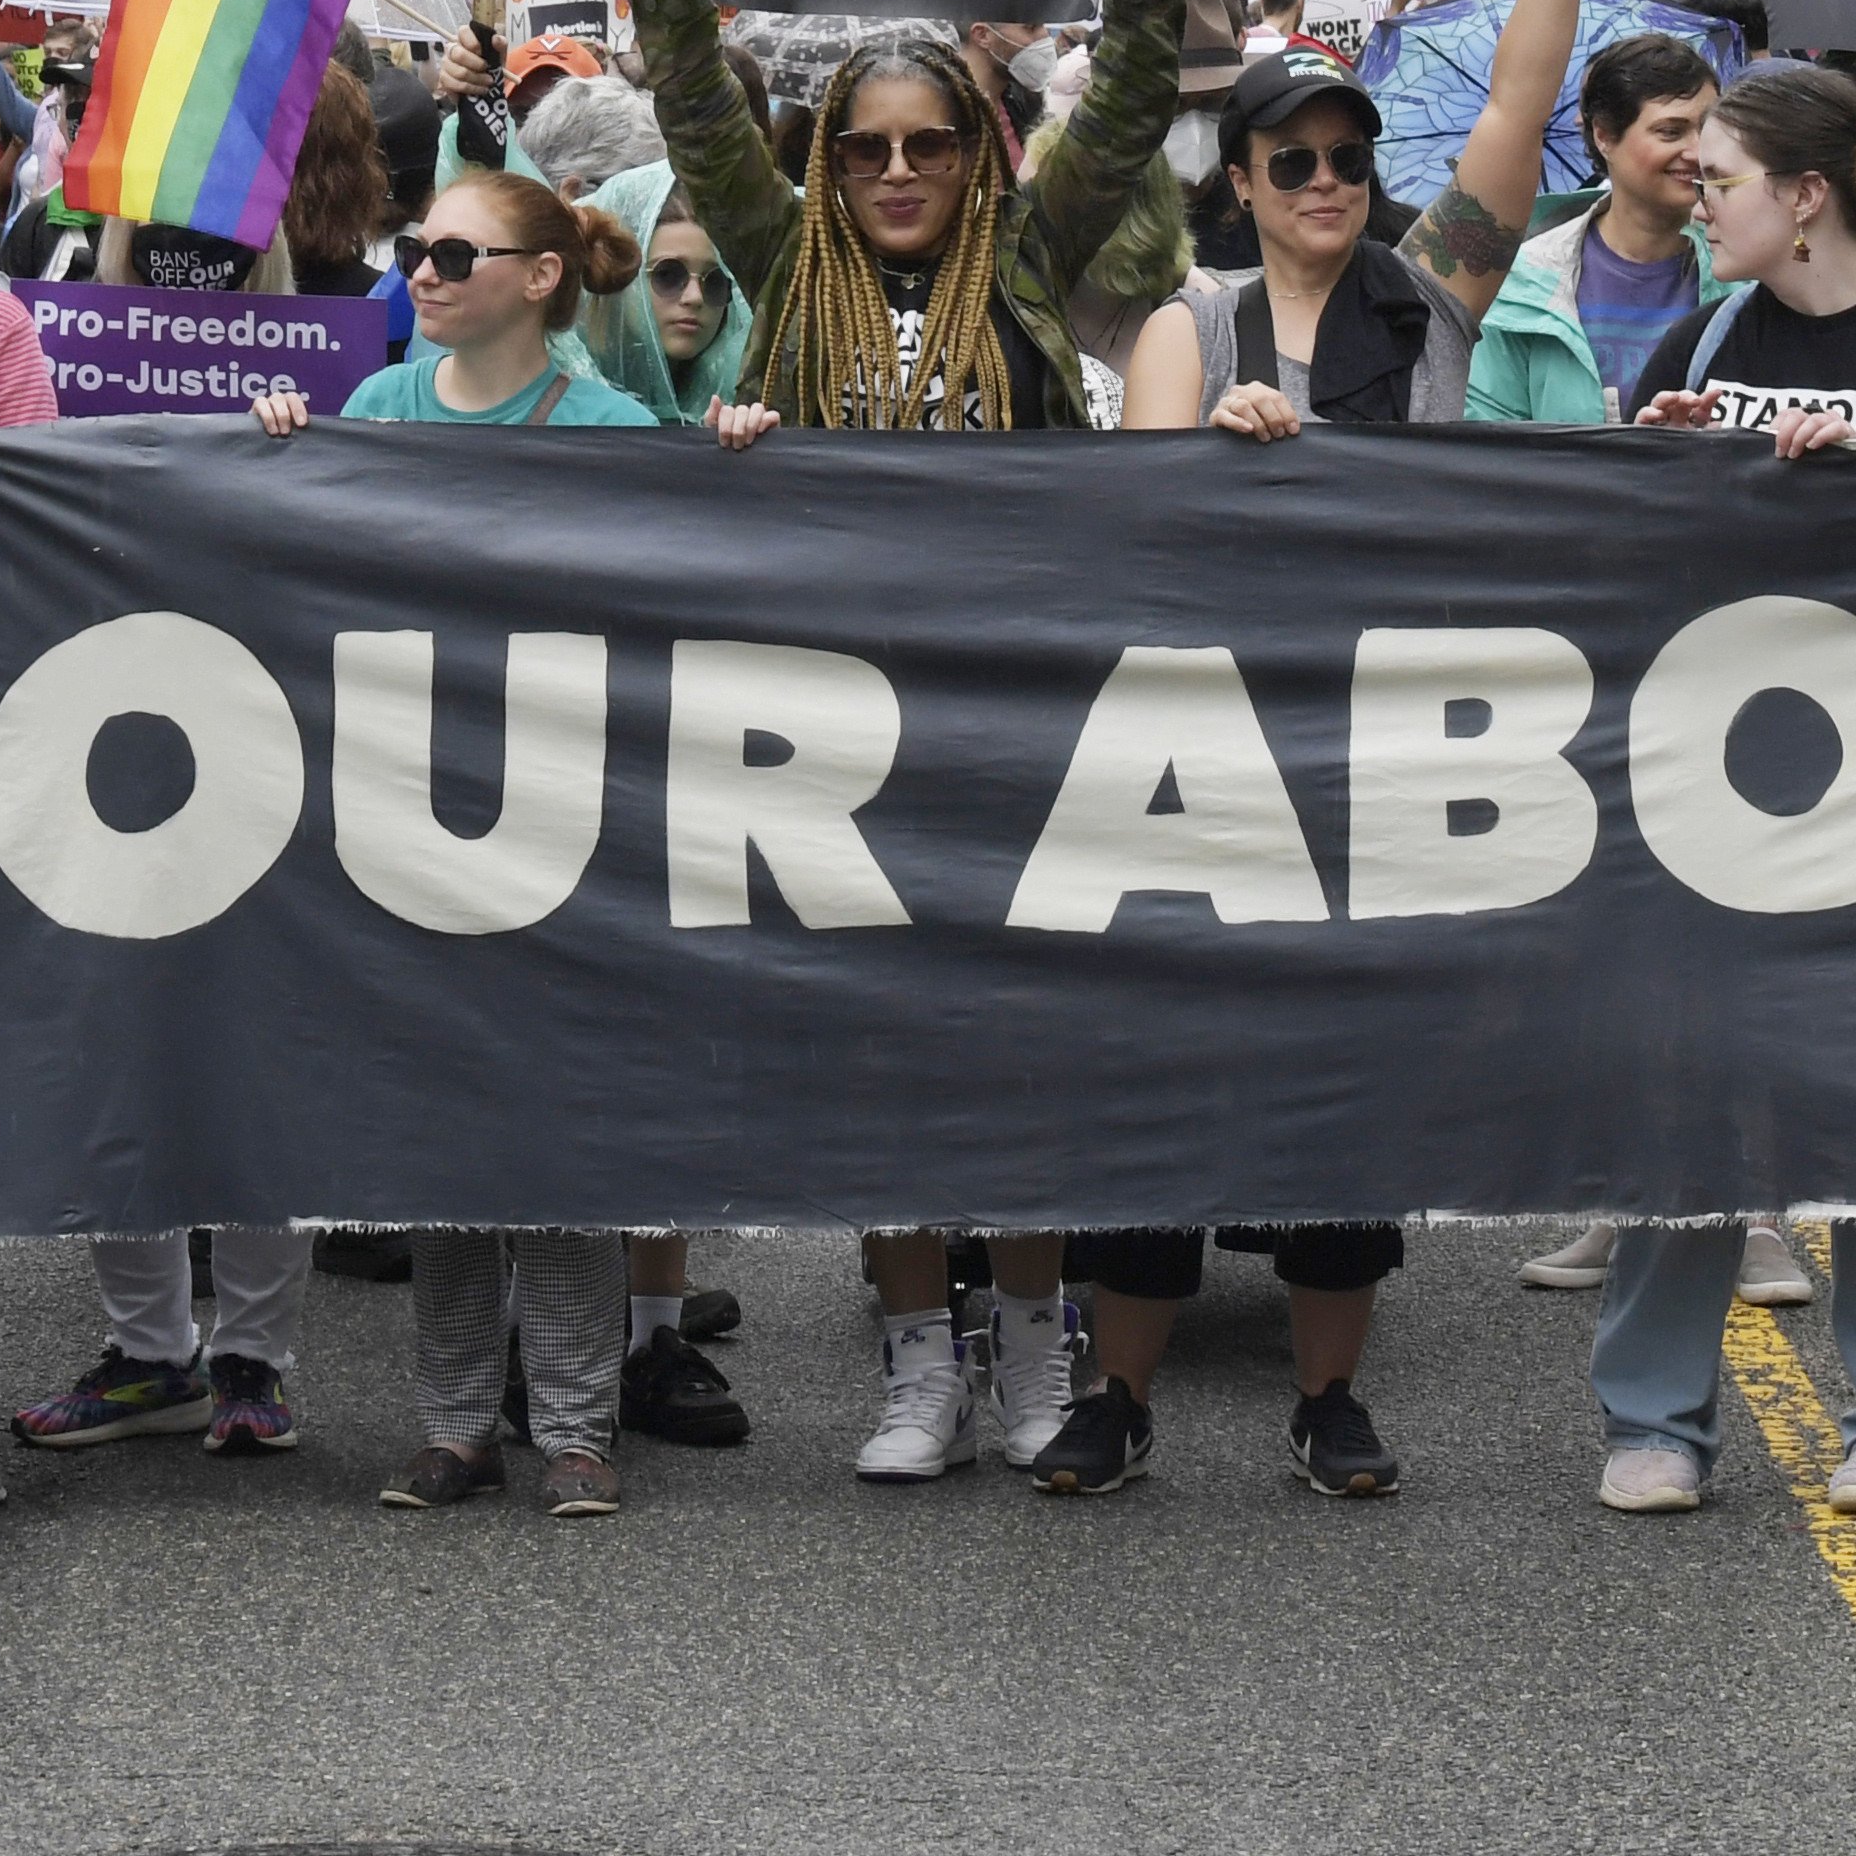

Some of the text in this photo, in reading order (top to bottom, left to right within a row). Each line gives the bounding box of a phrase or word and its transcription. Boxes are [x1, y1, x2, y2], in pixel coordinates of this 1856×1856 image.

[1307, 19, 1361, 36] WONT
[1328, 36, 1363, 52] ACK
[150, 250, 201, 267] BANS
[150, 260, 235, 284] OFF OUR
[33, 300, 341, 351] Pro-Freedom.
[1711, 389, 1856, 430] STAD
